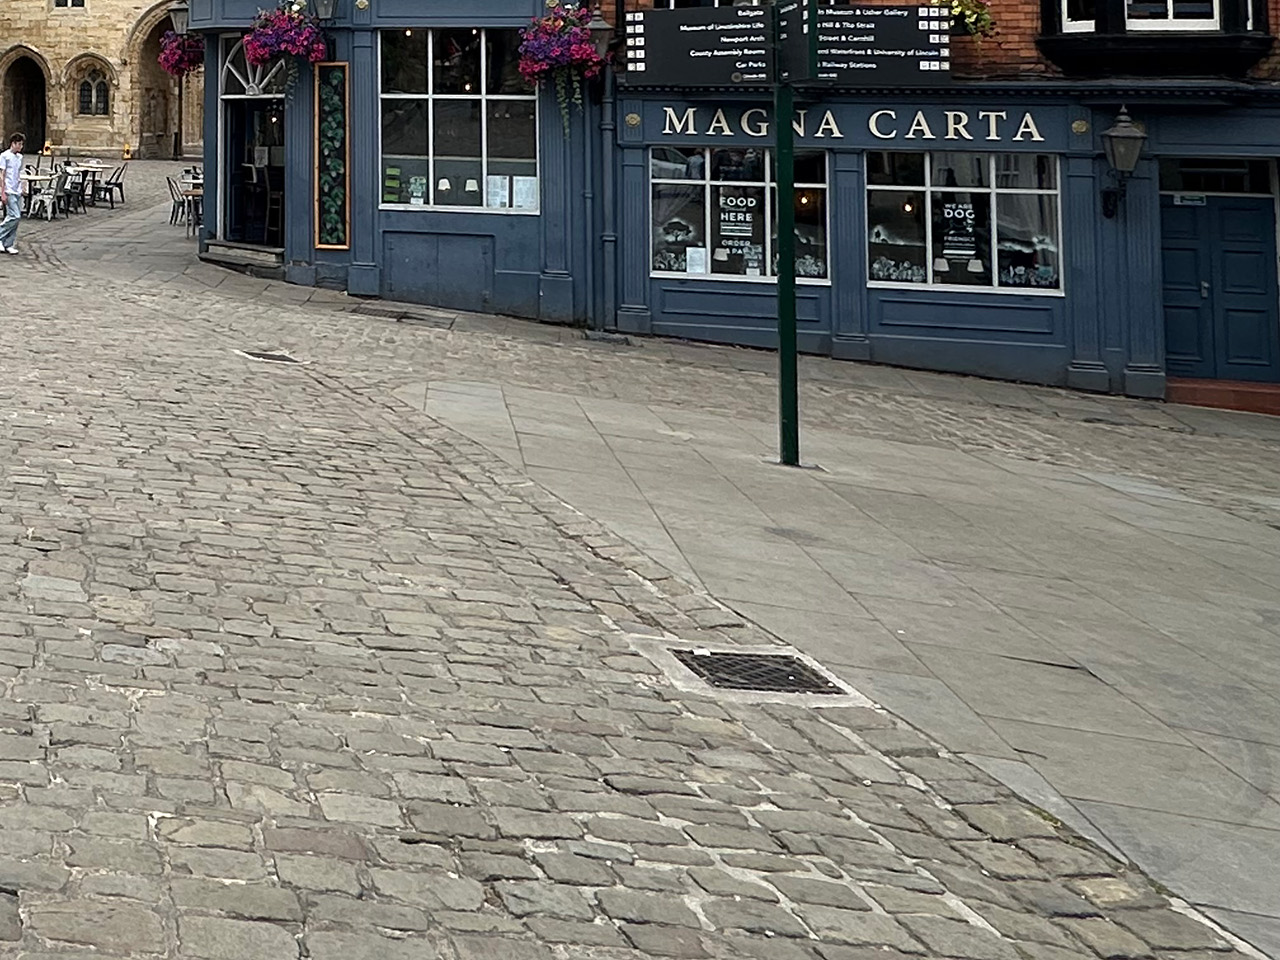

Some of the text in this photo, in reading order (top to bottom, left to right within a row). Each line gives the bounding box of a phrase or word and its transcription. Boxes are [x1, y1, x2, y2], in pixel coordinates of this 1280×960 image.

[868, 109, 1045, 142] CARTA
[720, 196, 757, 207] FOOD
[720, 212, 753, 222] HERE
[943, 208, 975, 219] DOG
